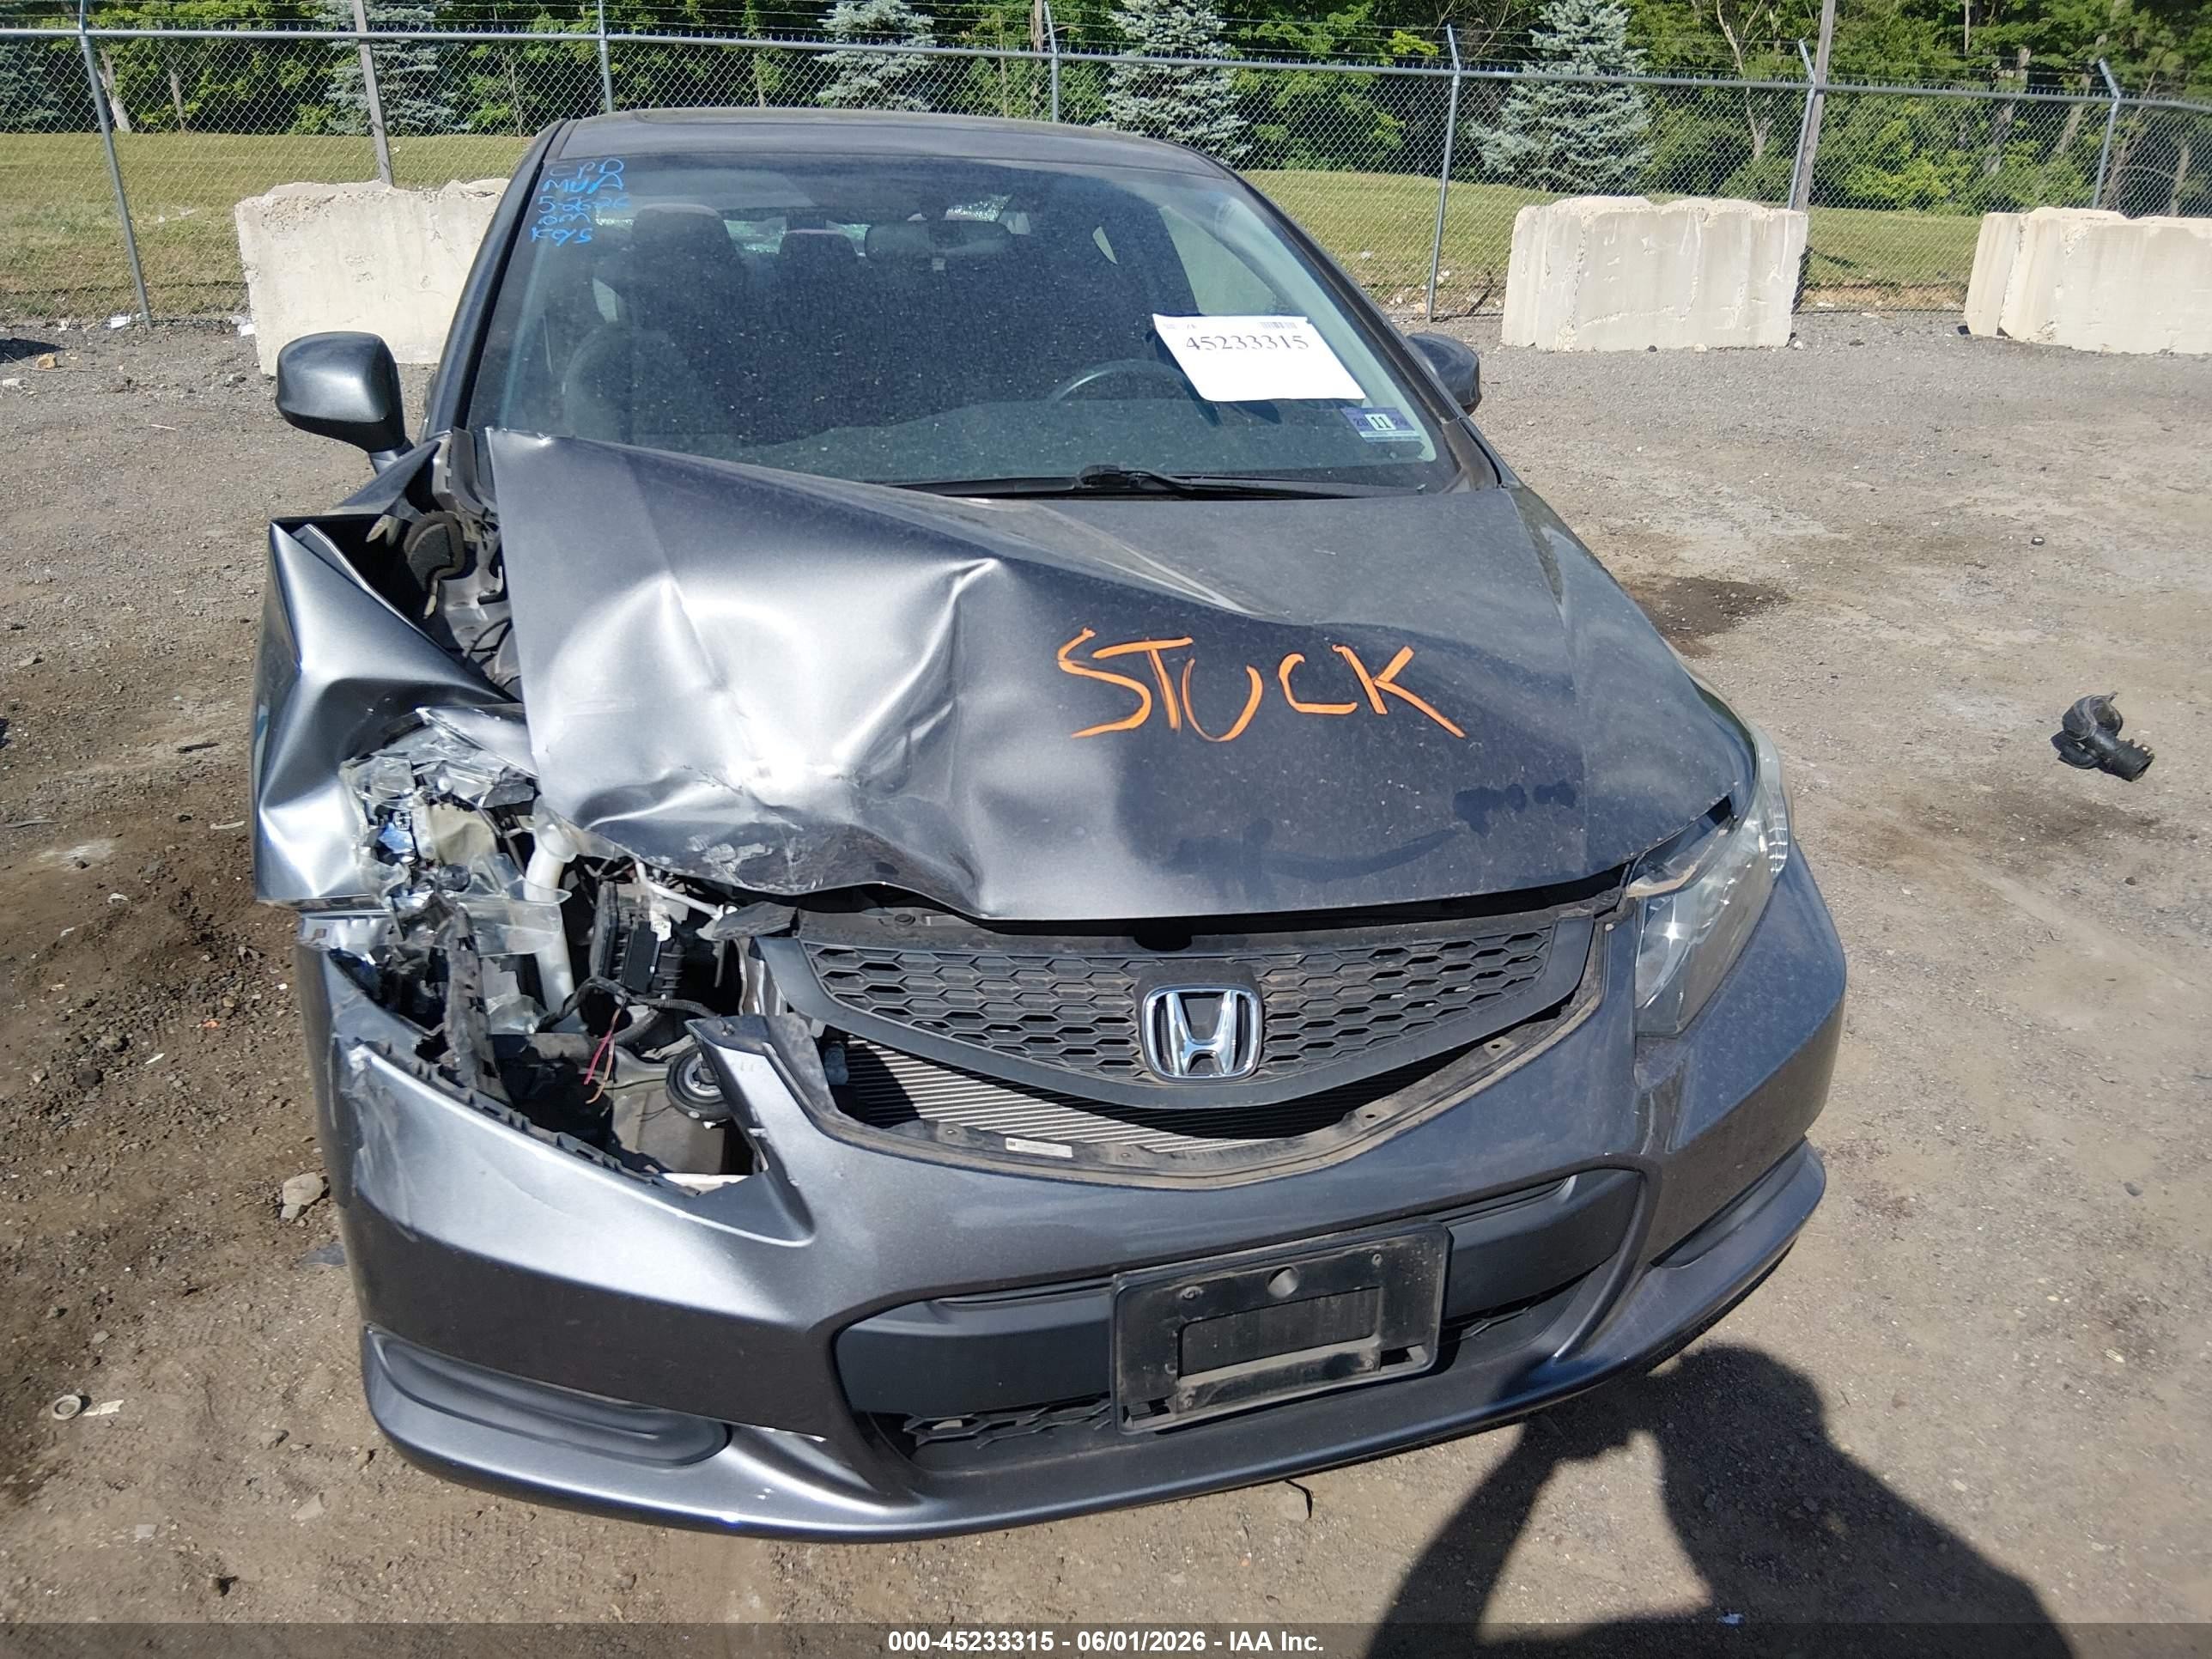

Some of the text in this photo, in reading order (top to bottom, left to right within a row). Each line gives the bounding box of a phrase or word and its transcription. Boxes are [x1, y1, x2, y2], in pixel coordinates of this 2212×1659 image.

[1185, 334, 1310, 351] 45233315
[1370, 416, 1392, 429] 11
[1057, 627, 1467, 744] STUCK
